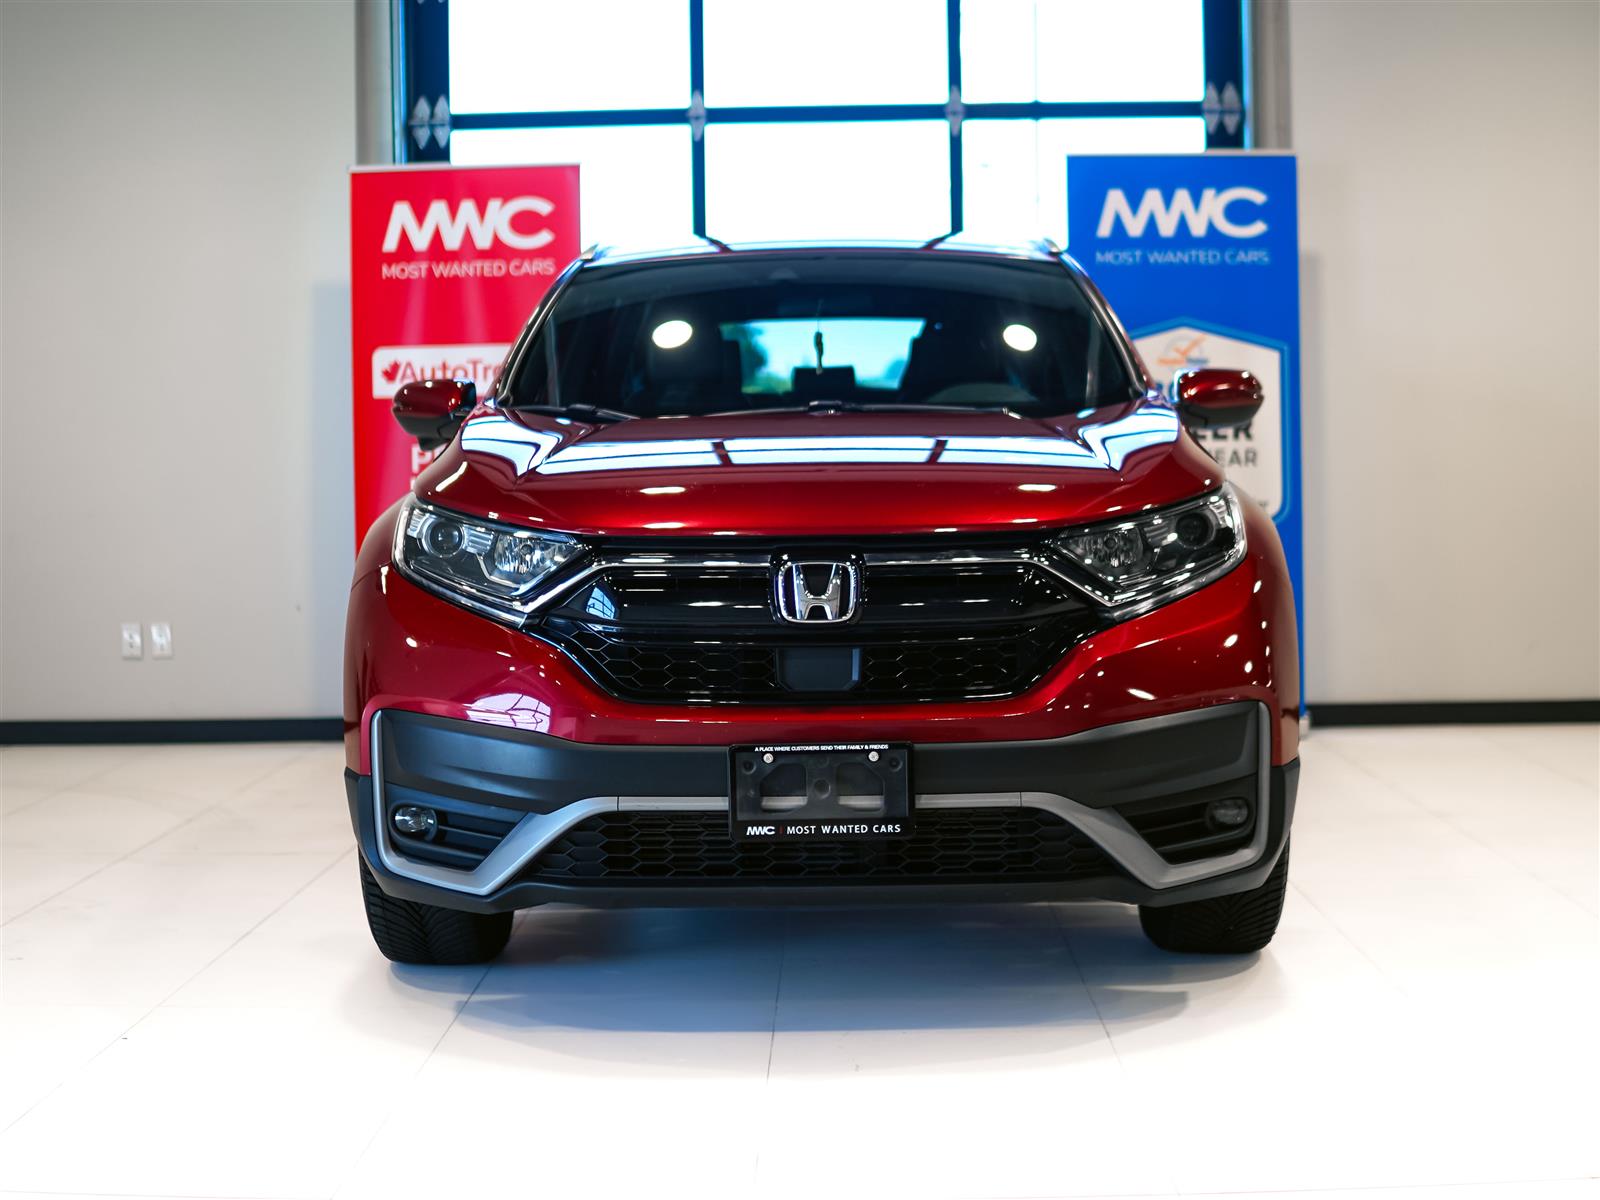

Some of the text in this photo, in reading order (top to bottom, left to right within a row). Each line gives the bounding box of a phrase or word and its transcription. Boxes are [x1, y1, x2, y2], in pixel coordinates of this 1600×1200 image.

[1096, 186, 1268, 238] MWC
[381, 195, 556, 253] MWC
[381, 257, 556, 280] MOST WANTED CARS
[1095, 249, 1270, 266] MOST WANTED CARS
[746, 824, 901, 836] MWC MOST WANTED CARS
